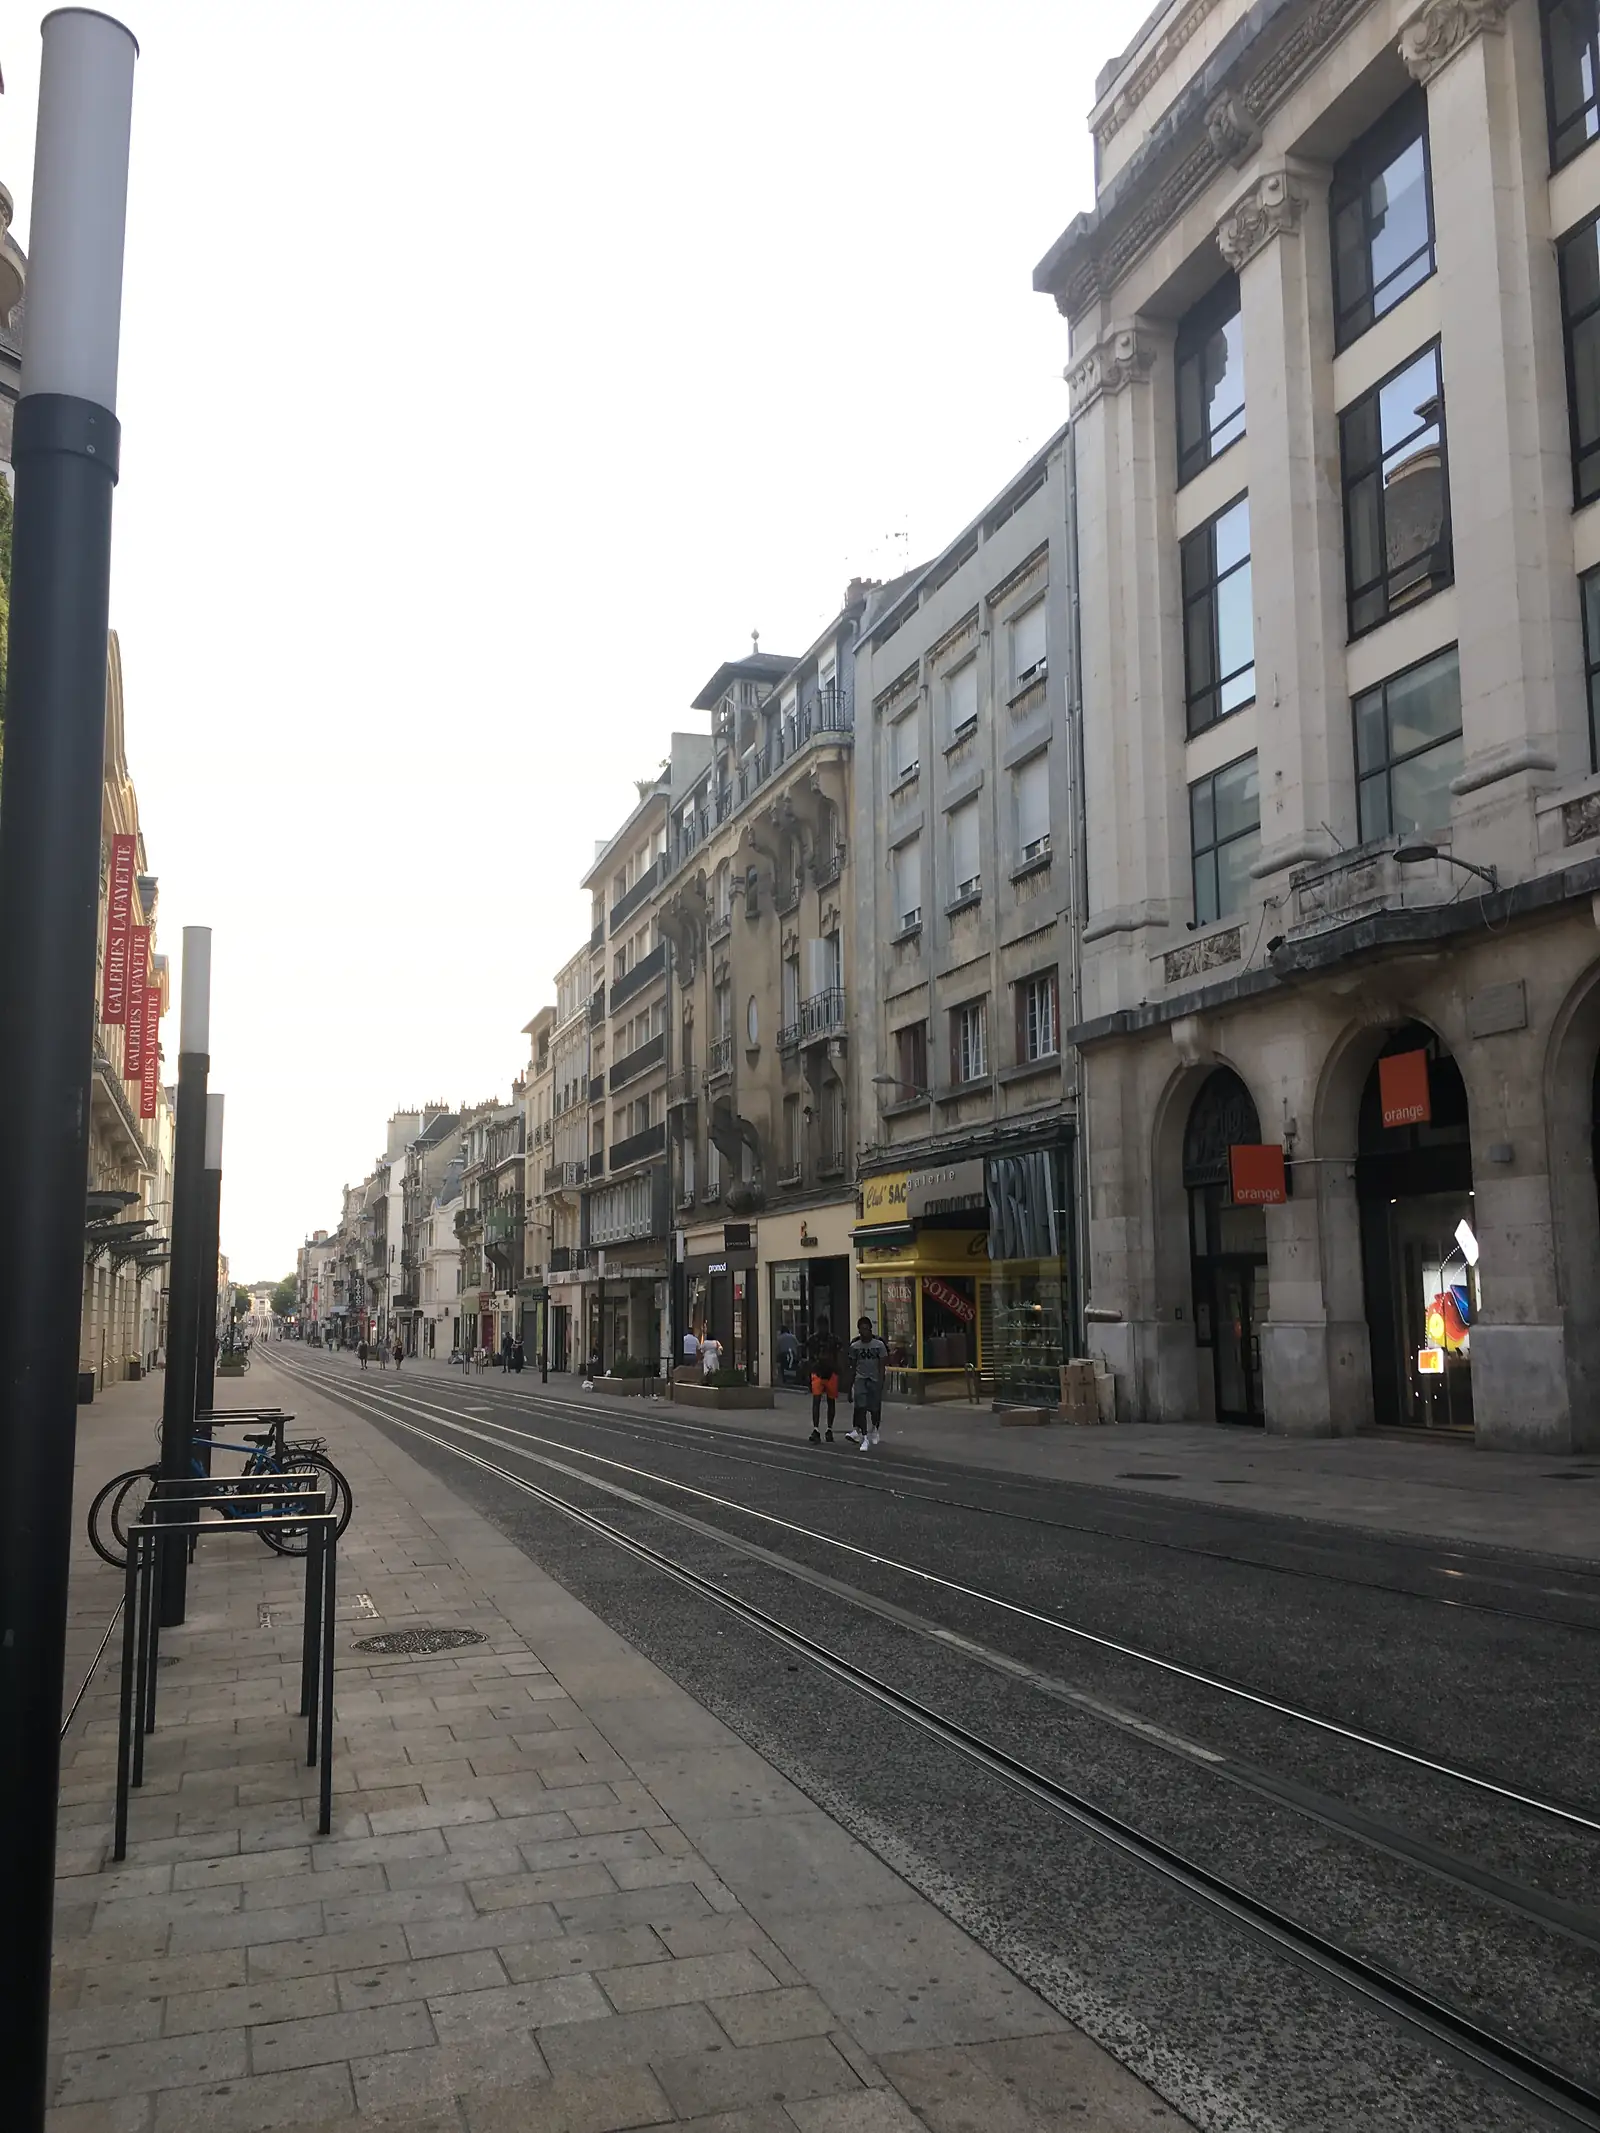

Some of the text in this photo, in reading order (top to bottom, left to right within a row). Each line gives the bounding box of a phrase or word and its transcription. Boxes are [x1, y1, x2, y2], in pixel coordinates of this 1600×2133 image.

[108, 845, 131, 1014] GALERIES LAFAYETTE
[128, 934, 146, 1072] GALERIES LAFAYETTE
[143, 994, 159, 1112] GALERIES LAFAYETTE
[1384, 1104, 1424, 1122] orange
[906, 1170, 956, 1192] galerie
[1237, 1187, 1281, 1201] orange
[708, 1262, 727, 1275] promod
[922, 1277, 976, 1322] SOLDES
